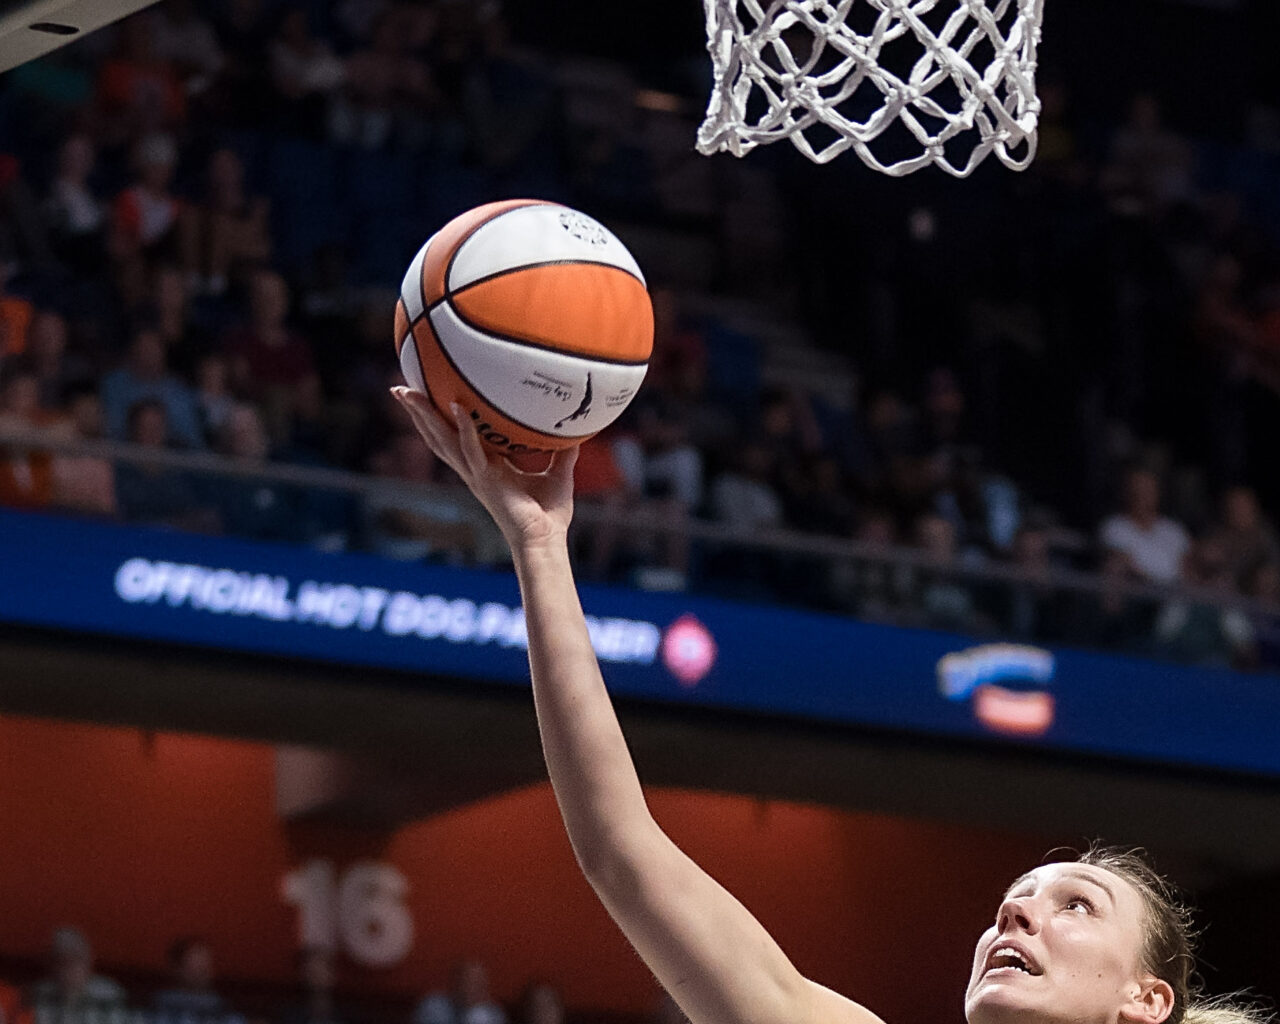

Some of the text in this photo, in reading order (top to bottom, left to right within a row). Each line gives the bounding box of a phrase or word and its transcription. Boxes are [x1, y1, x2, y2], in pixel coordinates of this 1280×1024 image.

[114, 557, 293, 622] OFFICIAL
[296, 579, 389, 632] HOT
[382, 591, 477, 643] DOG
[280, 861, 415, 967] 16
